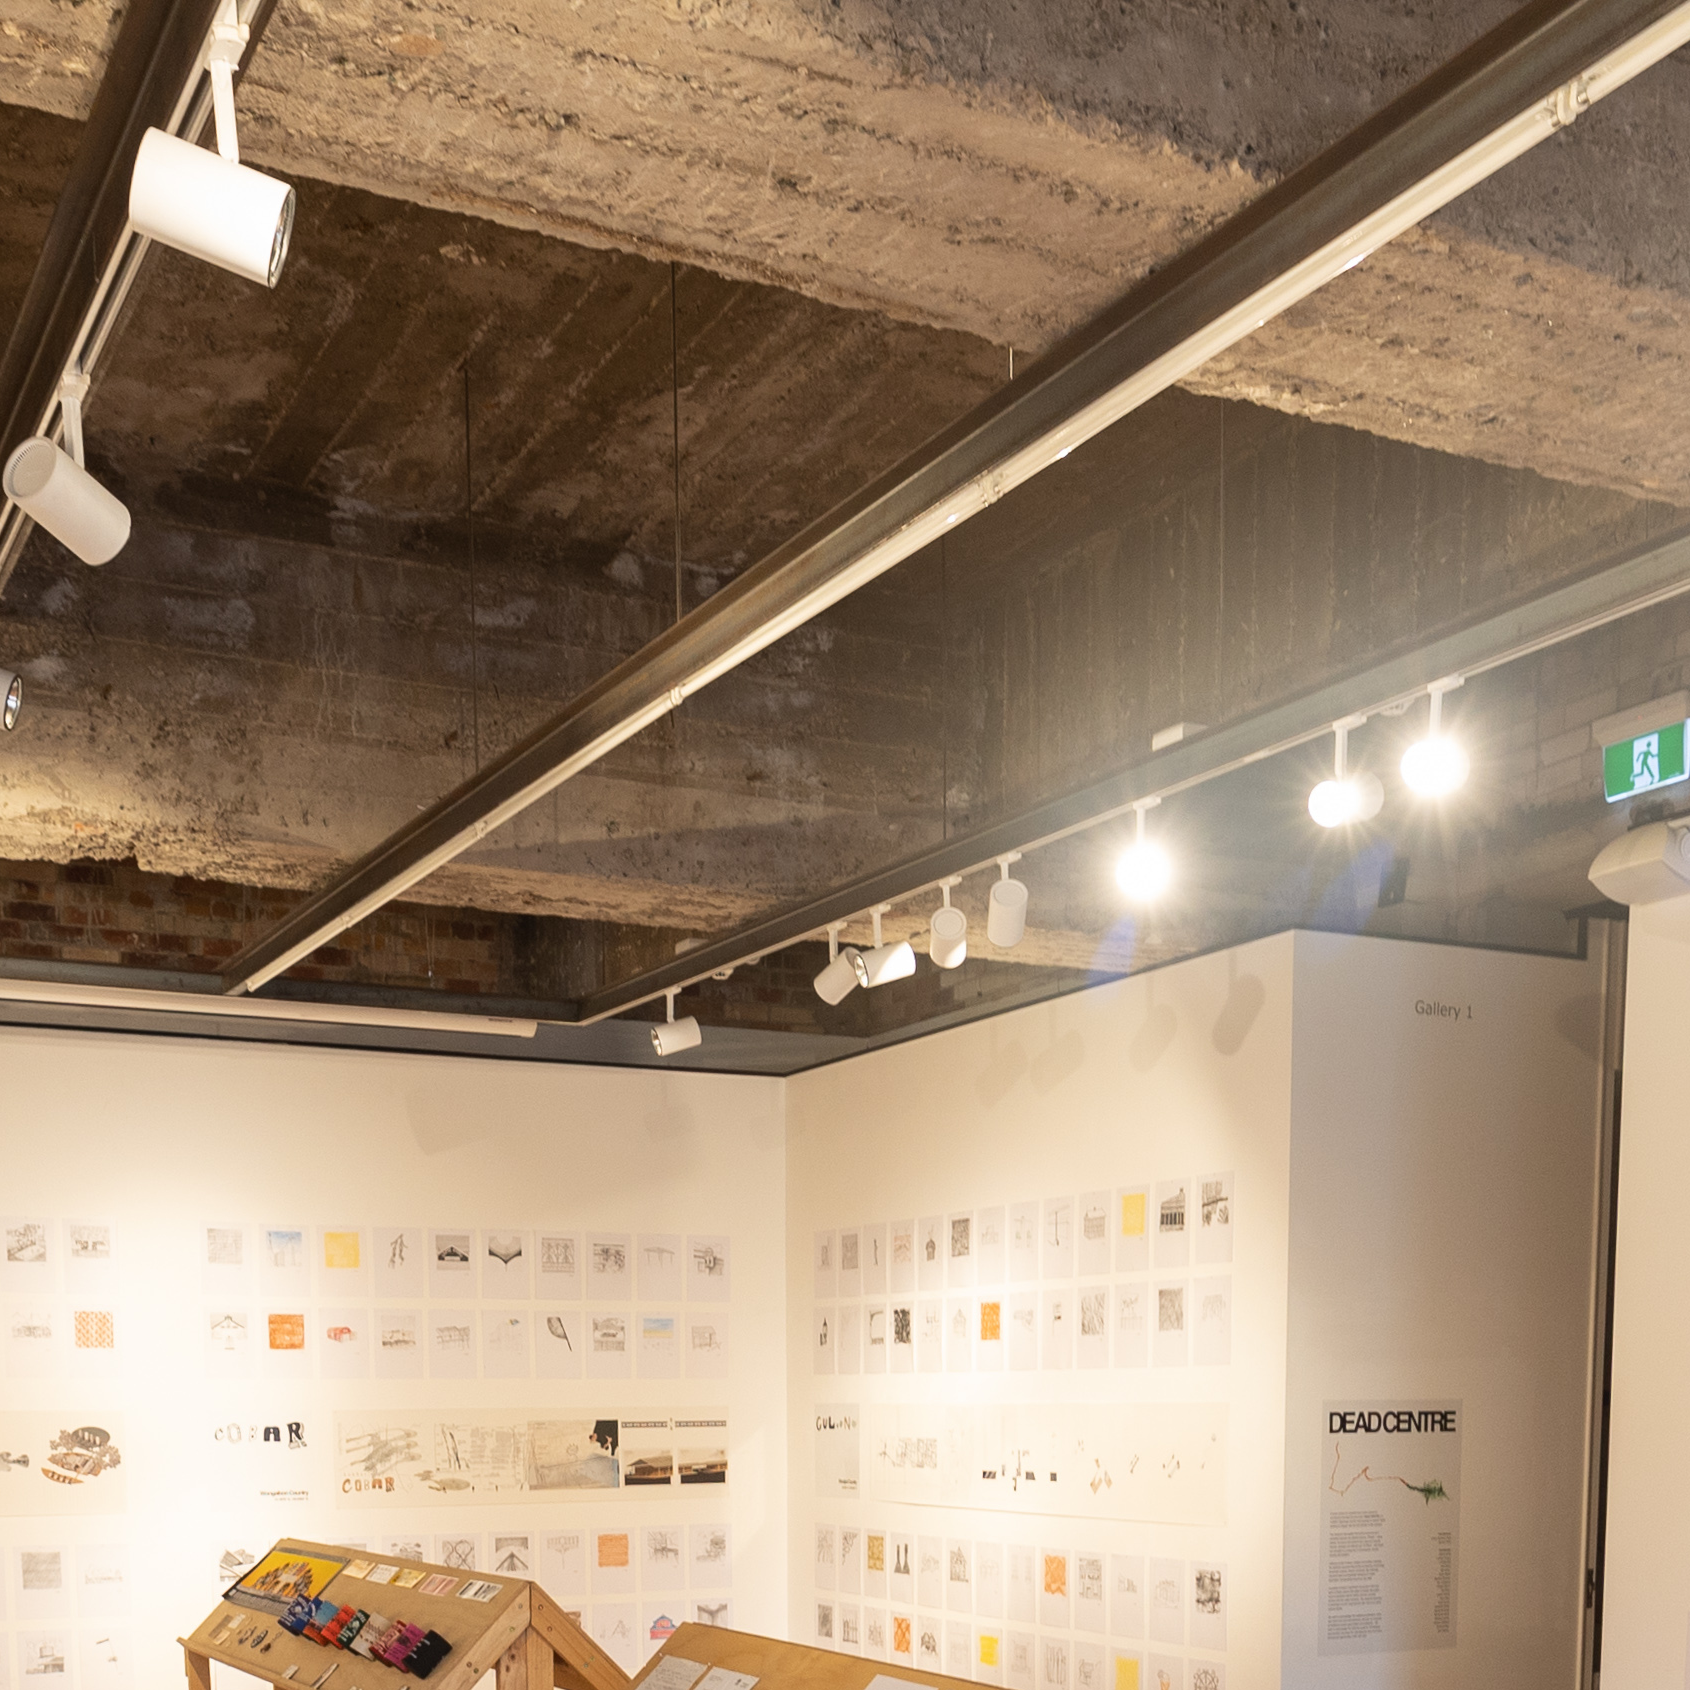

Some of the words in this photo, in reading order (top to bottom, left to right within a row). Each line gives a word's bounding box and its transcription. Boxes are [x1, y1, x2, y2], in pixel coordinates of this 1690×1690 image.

[1415, 999, 1461, 1022] Gallery
[1466, 1005, 1473, 1020] 1
[1328, 1411, 1382, 1434] DEAD
[1383, 1410, 1457, 1433] CENTRE
